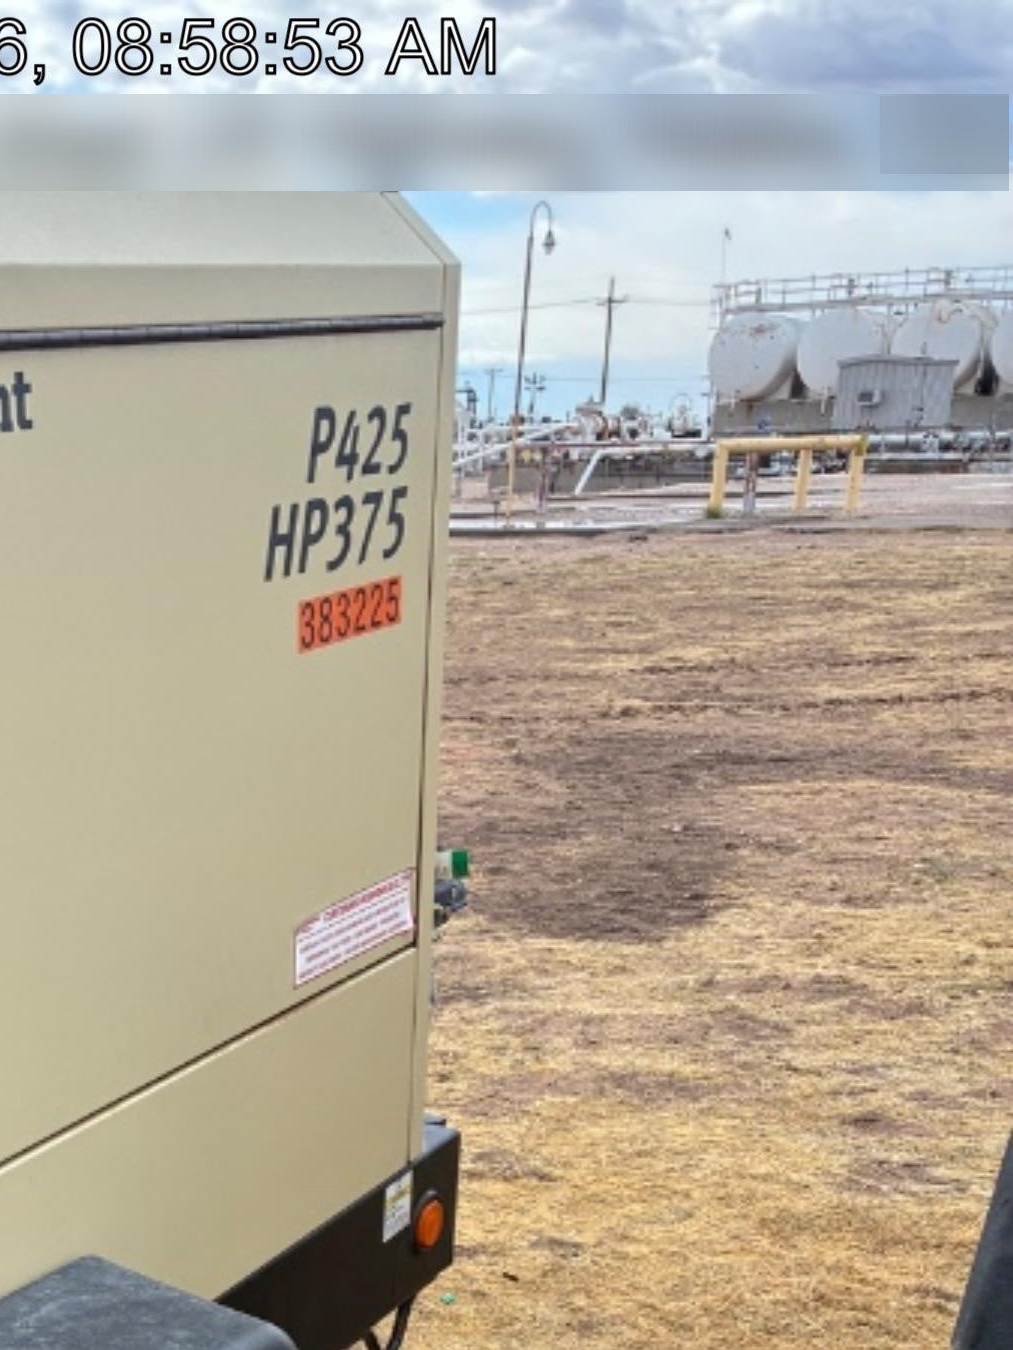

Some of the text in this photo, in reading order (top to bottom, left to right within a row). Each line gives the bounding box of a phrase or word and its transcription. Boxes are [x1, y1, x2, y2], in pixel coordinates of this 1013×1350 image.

[307, 402, 411, 483] P425
[264, 486, 408, 581] HP375
[300, 579, 400, 650] 383225
